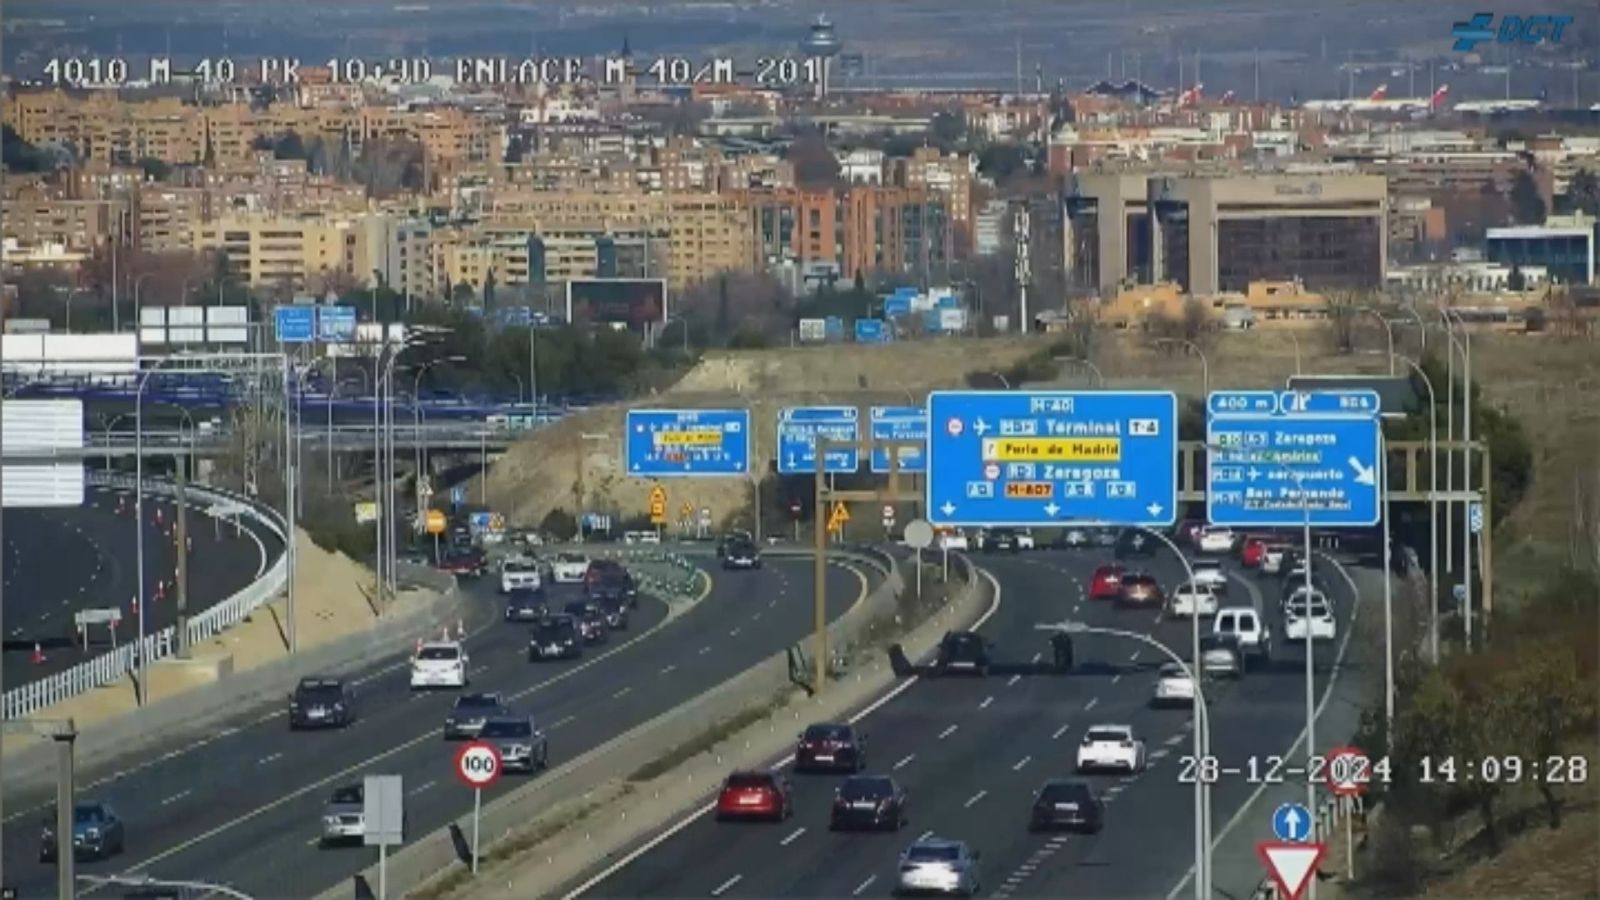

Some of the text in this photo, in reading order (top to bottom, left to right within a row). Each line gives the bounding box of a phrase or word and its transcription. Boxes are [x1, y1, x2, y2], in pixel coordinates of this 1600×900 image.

[1217, 397, 1248, 409] 400
[1045, 418, 1121, 435] Terminal
[1043, 464, 1121, 482] Zaragoza
[465, 756, 494, 773] 100
